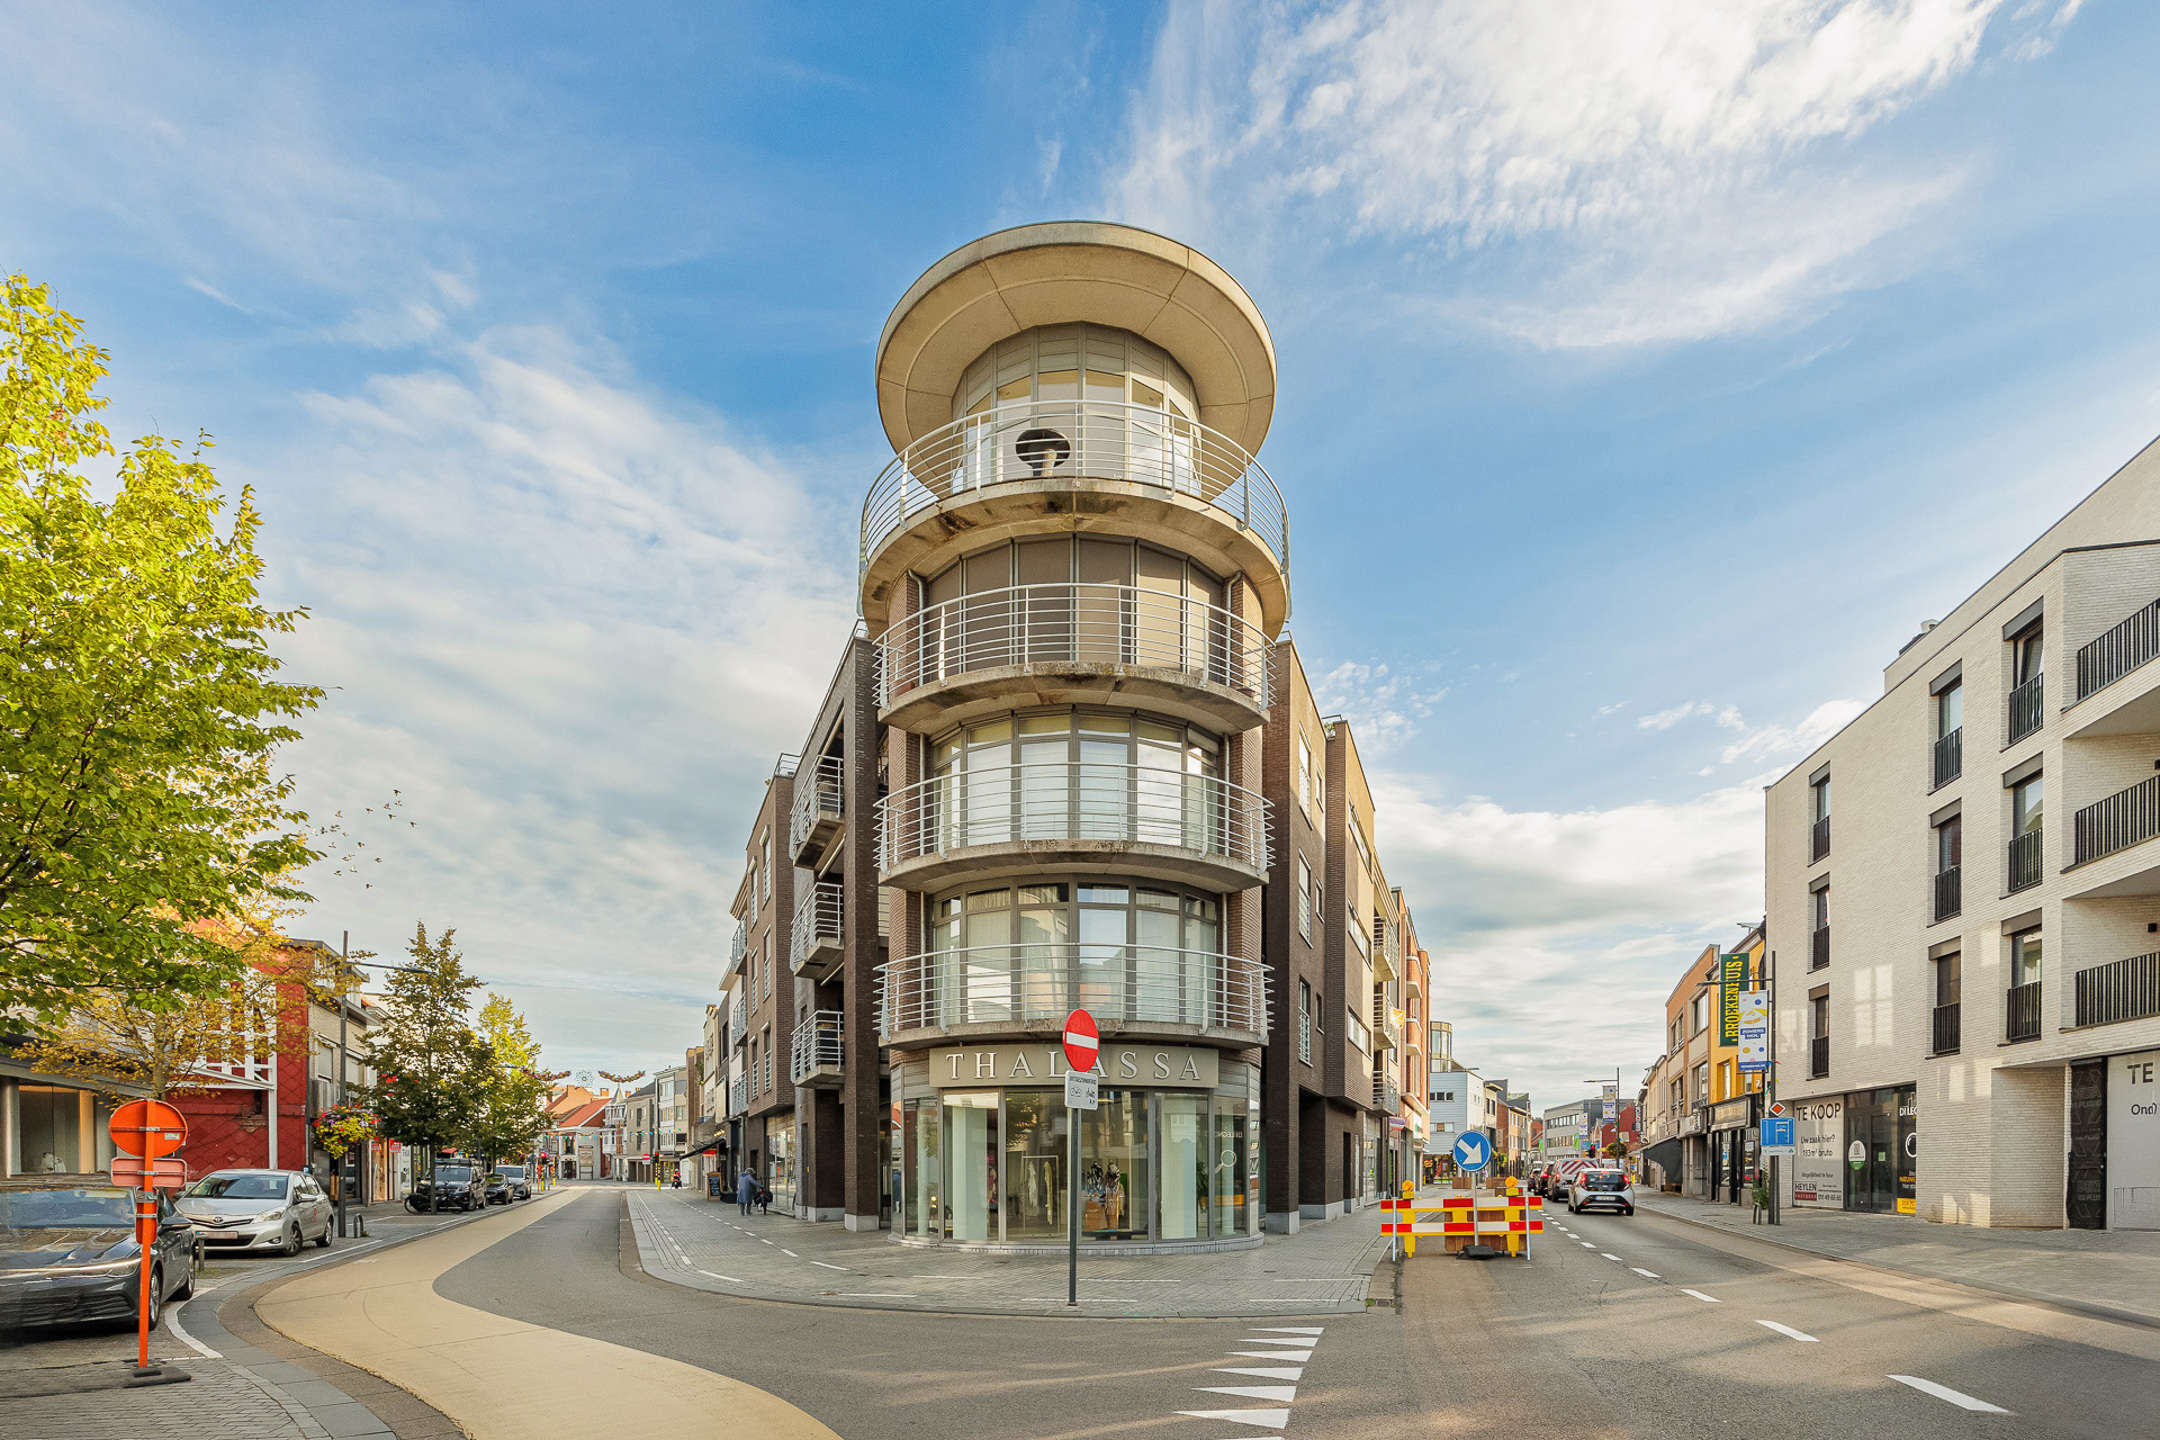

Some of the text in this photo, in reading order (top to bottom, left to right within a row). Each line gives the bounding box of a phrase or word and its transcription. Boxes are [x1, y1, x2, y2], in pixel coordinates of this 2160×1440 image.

[2127, 1062, 2154, 1085] TE
[1797, 1103, 1841, 1121] TE KOOP
[1795, 1183, 1816, 1191] HEYLEN
